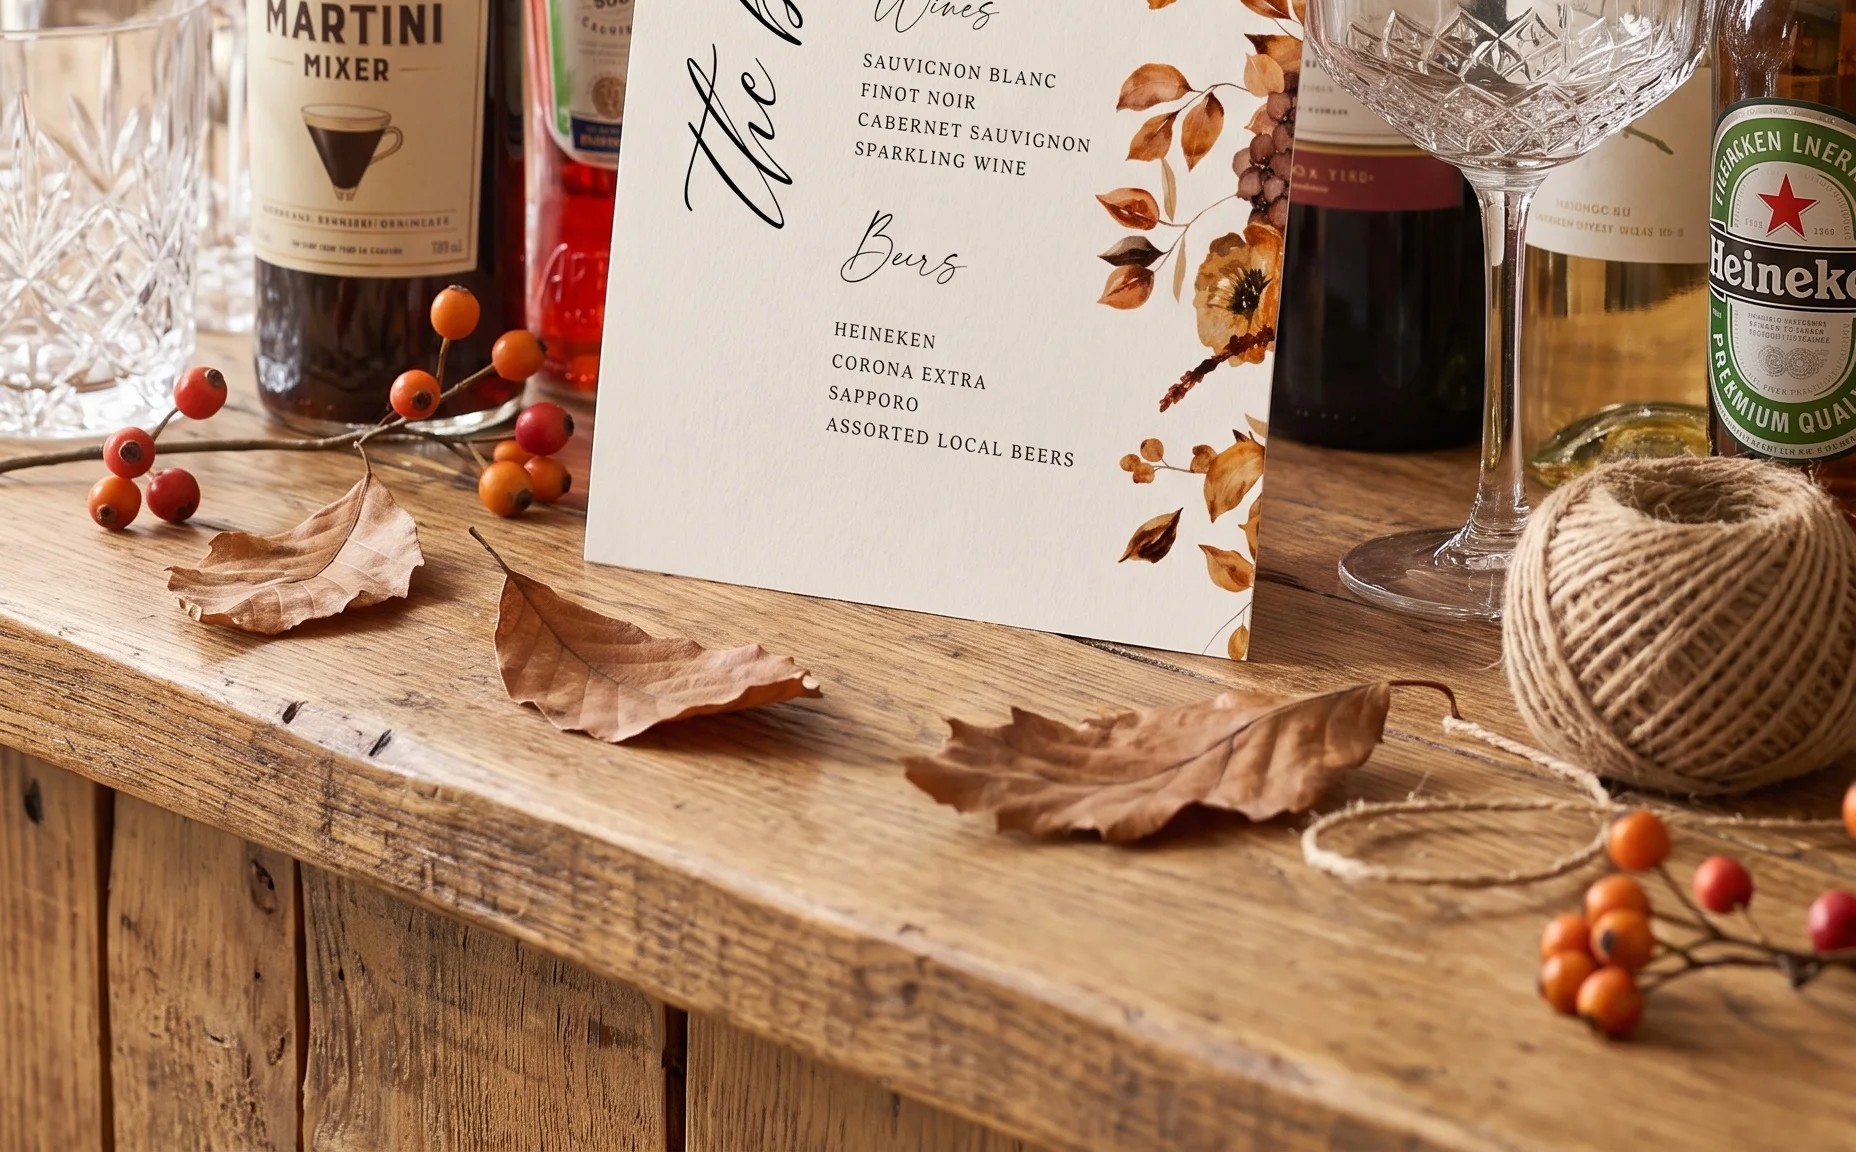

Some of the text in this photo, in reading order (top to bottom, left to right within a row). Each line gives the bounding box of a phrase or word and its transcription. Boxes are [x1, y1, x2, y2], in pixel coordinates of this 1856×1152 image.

[303, 52, 390, 82] MIXER
[989, 67, 1057, 89] BLANC
[860, 82, 976, 110] FINOT NOIR
[684, 43, 794, 230] the
[857, 112, 1091, 153] CABERNET SAUVIGNON
[854, 140, 1026, 176] SPARKLING WINE
[834, 321, 936, 350] HEINEKEN
[831, 353, 986, 390] CORONA EXTRA
[828, 385, 919, 413] SAPPORO
[1798, 388, 1856, 435] QUAL
[825, 417, 1074, 468] ASSORTED LOCAL BEERS
